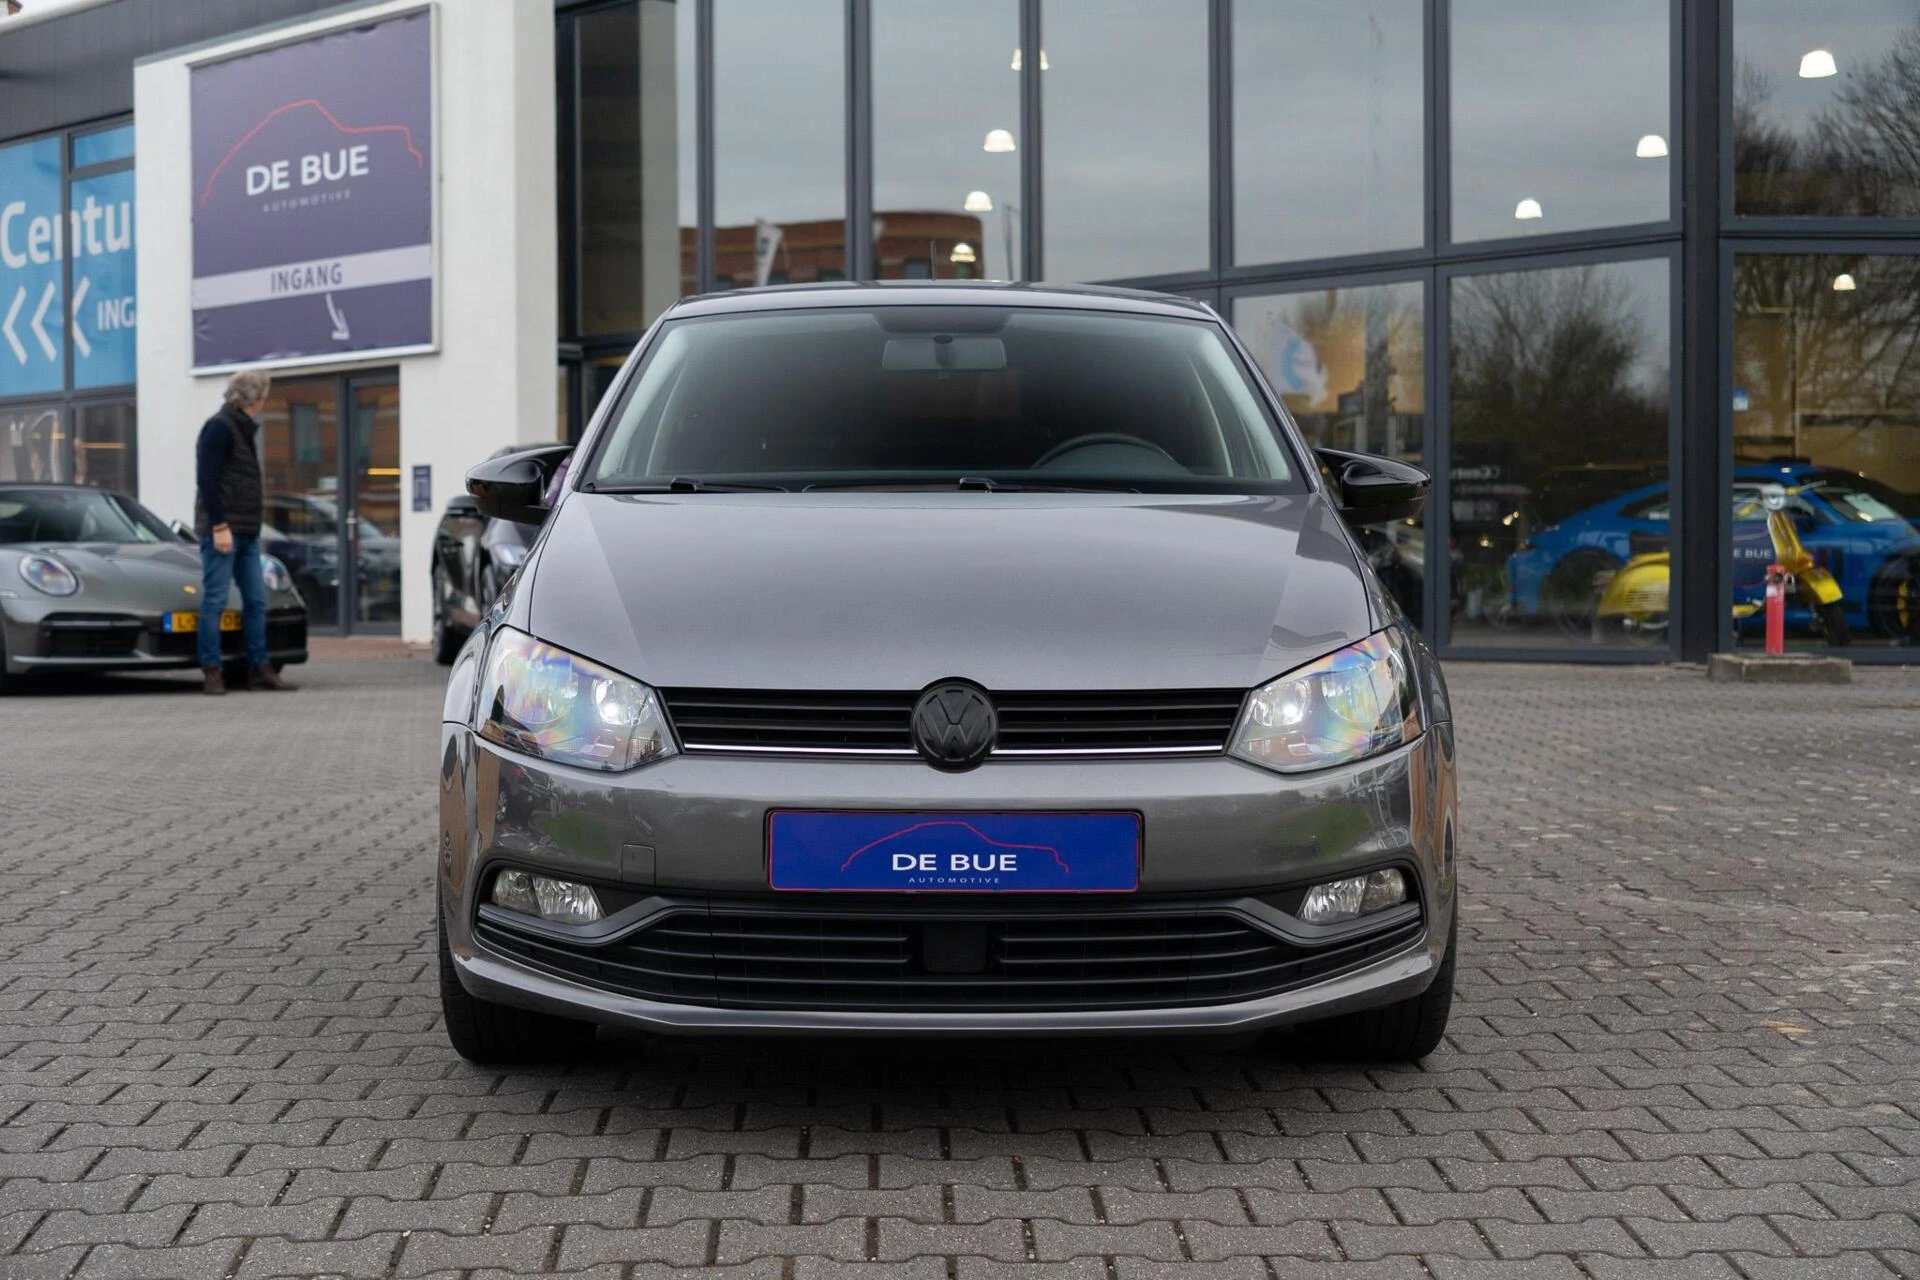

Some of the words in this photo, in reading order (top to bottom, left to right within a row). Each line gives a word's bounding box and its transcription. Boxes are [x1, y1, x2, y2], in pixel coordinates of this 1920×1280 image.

[246, 160, 290, 196] DE
[301, 144, 369, 185] BUE
[270, 262, 342, 294] INGANG
[1745, 547, 1772, 559] BUE
[892, 854, 937, 871] DE
[950, 854, 1017, 871] BUE
